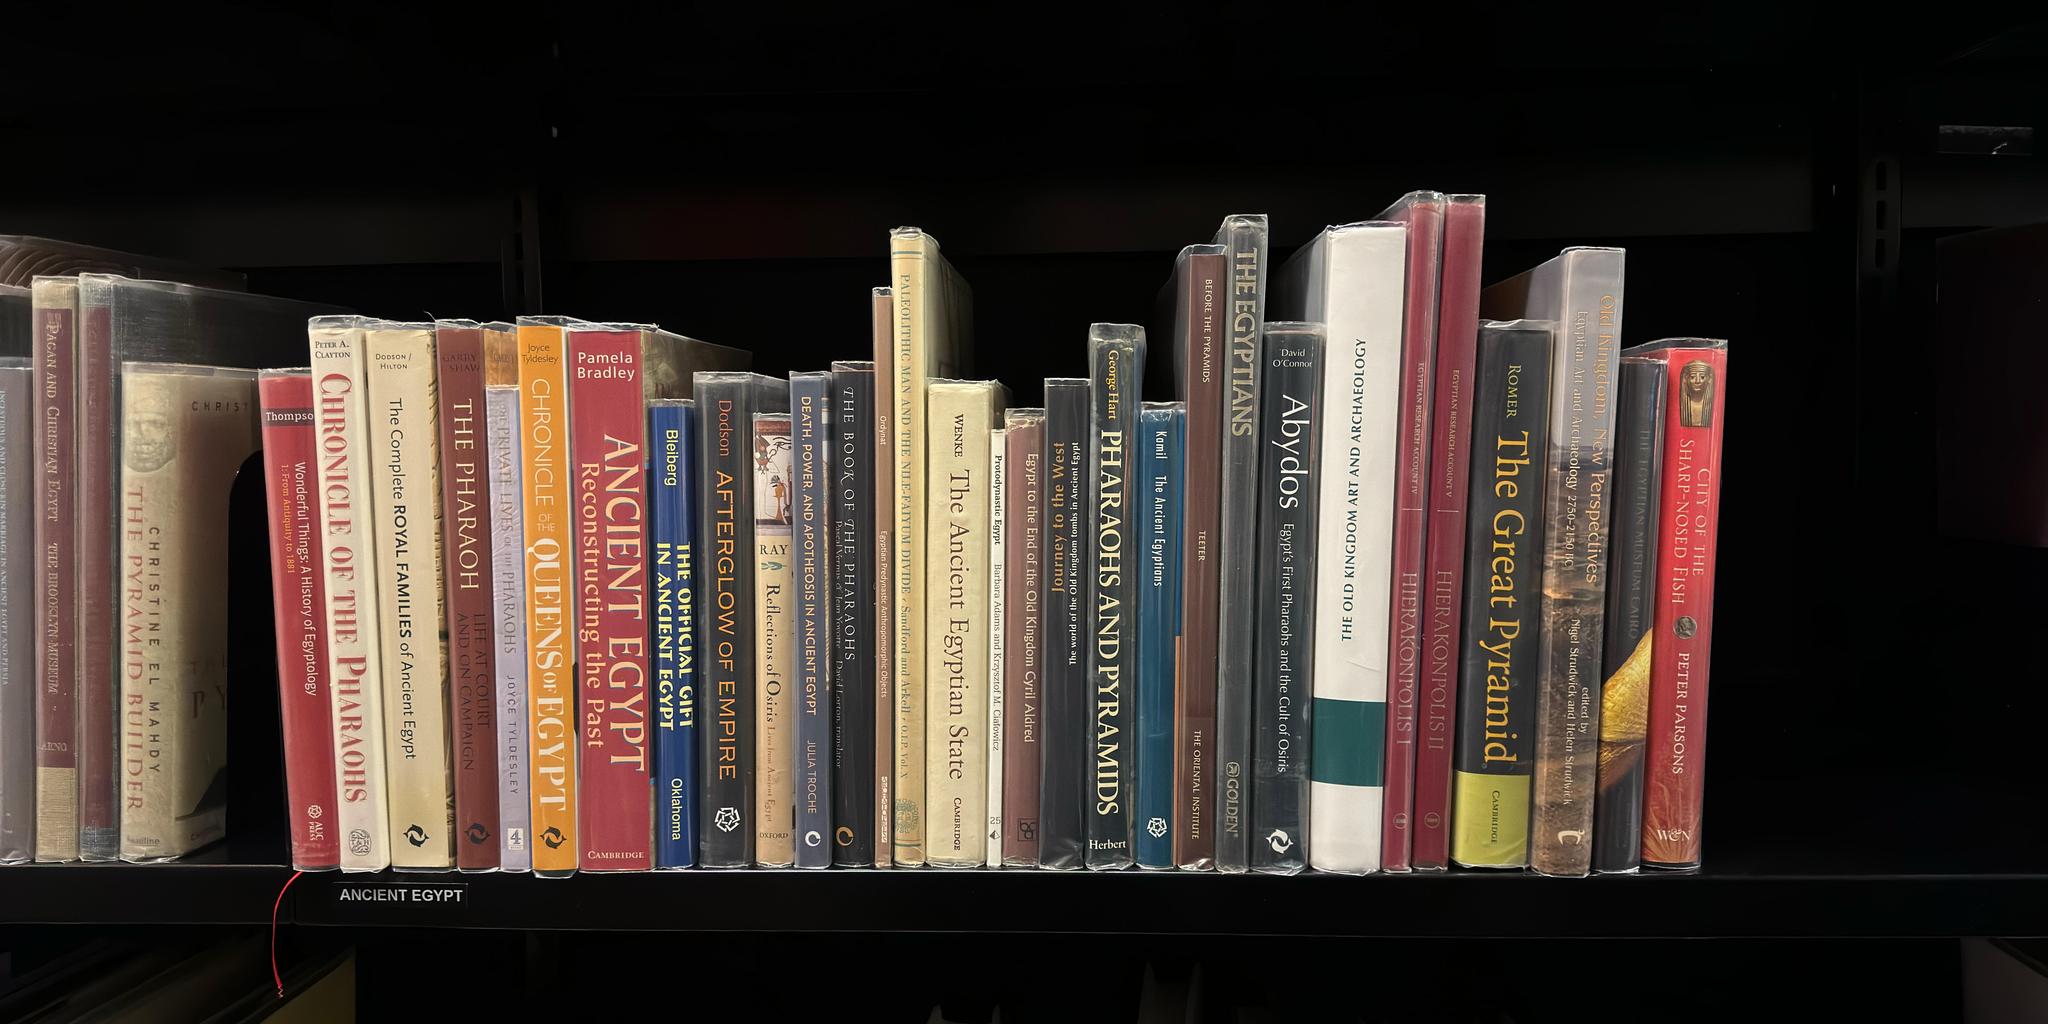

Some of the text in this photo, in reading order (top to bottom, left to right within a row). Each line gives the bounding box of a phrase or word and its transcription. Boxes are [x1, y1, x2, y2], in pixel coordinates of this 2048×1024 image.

[577, 367, 635, 381] Bradley
[578, 352, 632, 363] Pamela
[1202, 280, 1213, 382] BEFORE THE PYRAMIDS
[1231, 248, 1257, 436] THE EGYPTIANS
[46, 323, 60, 522] PAGAN AND CHRISTIAN EGYPT
[664, 430, 679, 486] Bleiberg
[802, 444, 813, 490] POWER,
[295, 462, 309, 520] Wonderful
[297, 523, 311, 563] Things:
[453, 399, 478, 589] THE PHARAOH
[803, 495, 814, 520] AND
[840, 387, 856, 660] THE BOOK OF THE PHARAOHS
[992, 456, 1002, 545] Protodynastic Egypt
[1052, 442, 1065, 592] Journey to the West
[1152, 431, 1167, 586] Kamil The Ancient Egyptians
[1198, 531, 1206, 561] TEETER
[1341, 339, 1366, 641] THE OLD KINGDOM ART AND ARCHAEOLOGY
[1672, 439, 1695, 603] SHARP-NOSED FISH
[1692, 468, 1709, 576] CITY OF THE
[299, 577, 313, 616] History
[320, 373, 368, 803] CHRONICLE OF THE PHARAOHS
[389, 398, 416, 759] The Complete ROYAL FAMILIES of Ancient Egypt
[580, 463, 606, 748] Reconstructing the Past
[604, 434, 644, 771] ANCIENT EGYPT
[716, 400, 735, 780] Dodson AFTERGLOW OF EMPIRE
[803, 524, 816, 600] APOTHEOSIS
[805, 604, 815, 616] IN
[879, 531, 888, 697] Egyptian Predynastic Anthropomorphic Objects
[943, 414, 970, 779] WENKE The Ancient Egyptian State
[1022, 454, 1038, 743] Egypt to the End of the Old Kingdom Cyril Aldred
[1096, 350, 1122, 815] George Hart PHARAOHS AND PYRAMIDS
[1272, 394, 1310, 773] Abydos Egypt's First Pharaohs and the Cult of Osiris
[1479, 365, 1529, 762] ROMER The Great Pyramid
[127, 486, 143, 812] THE PYRAMID BUILDER
[149, 527, 160, 773] CHRISTINE EL MAHDY
[303, 620, 315, 630] of
[303, 634, 318, 696] Egyptology
[528, 538, 566, 812] QUEENS OF EGYPT
[657, 543, 673, 731] IN ANCIENT EGYPT
[677, 542, 693, 728] THE OFFICIAL GIFT
[765, 584, 781, 722] Reflections of Osiris
[805, 619, 816, 673] ANCIENT
[1396, 572, 1417, 731] HIERAKONPOLIS
[1428, 570, 1452, 750] HIERAKONPOLIS II
[806, 676, 816, 715] EGYPT
[1563, 619, 1580, 805] Nigel Strudwick and Helen Strudwick
[1672, 653, 1689, 773] PETER PARSONS
[671, 778, 683, 840] Oklahoma
[807, 740, 817, 813] JULIA TROCHE
[953, 797, 961, 850] CAMBRIDGE
[1192, 796, 1200, 839] INSTITUTE
[1193, 750, 1201, 793] ORIENTAL
[1491, 790, 1500, 843] CAMBRIDGE
[340, 889, 463, 902] ANCIENT EGYPT
[588, 851, 644, 859] CAMBRIDGE
[1089, 839, 1126, 849] Herbert
[1657, 830, 1690, 841] W&N
